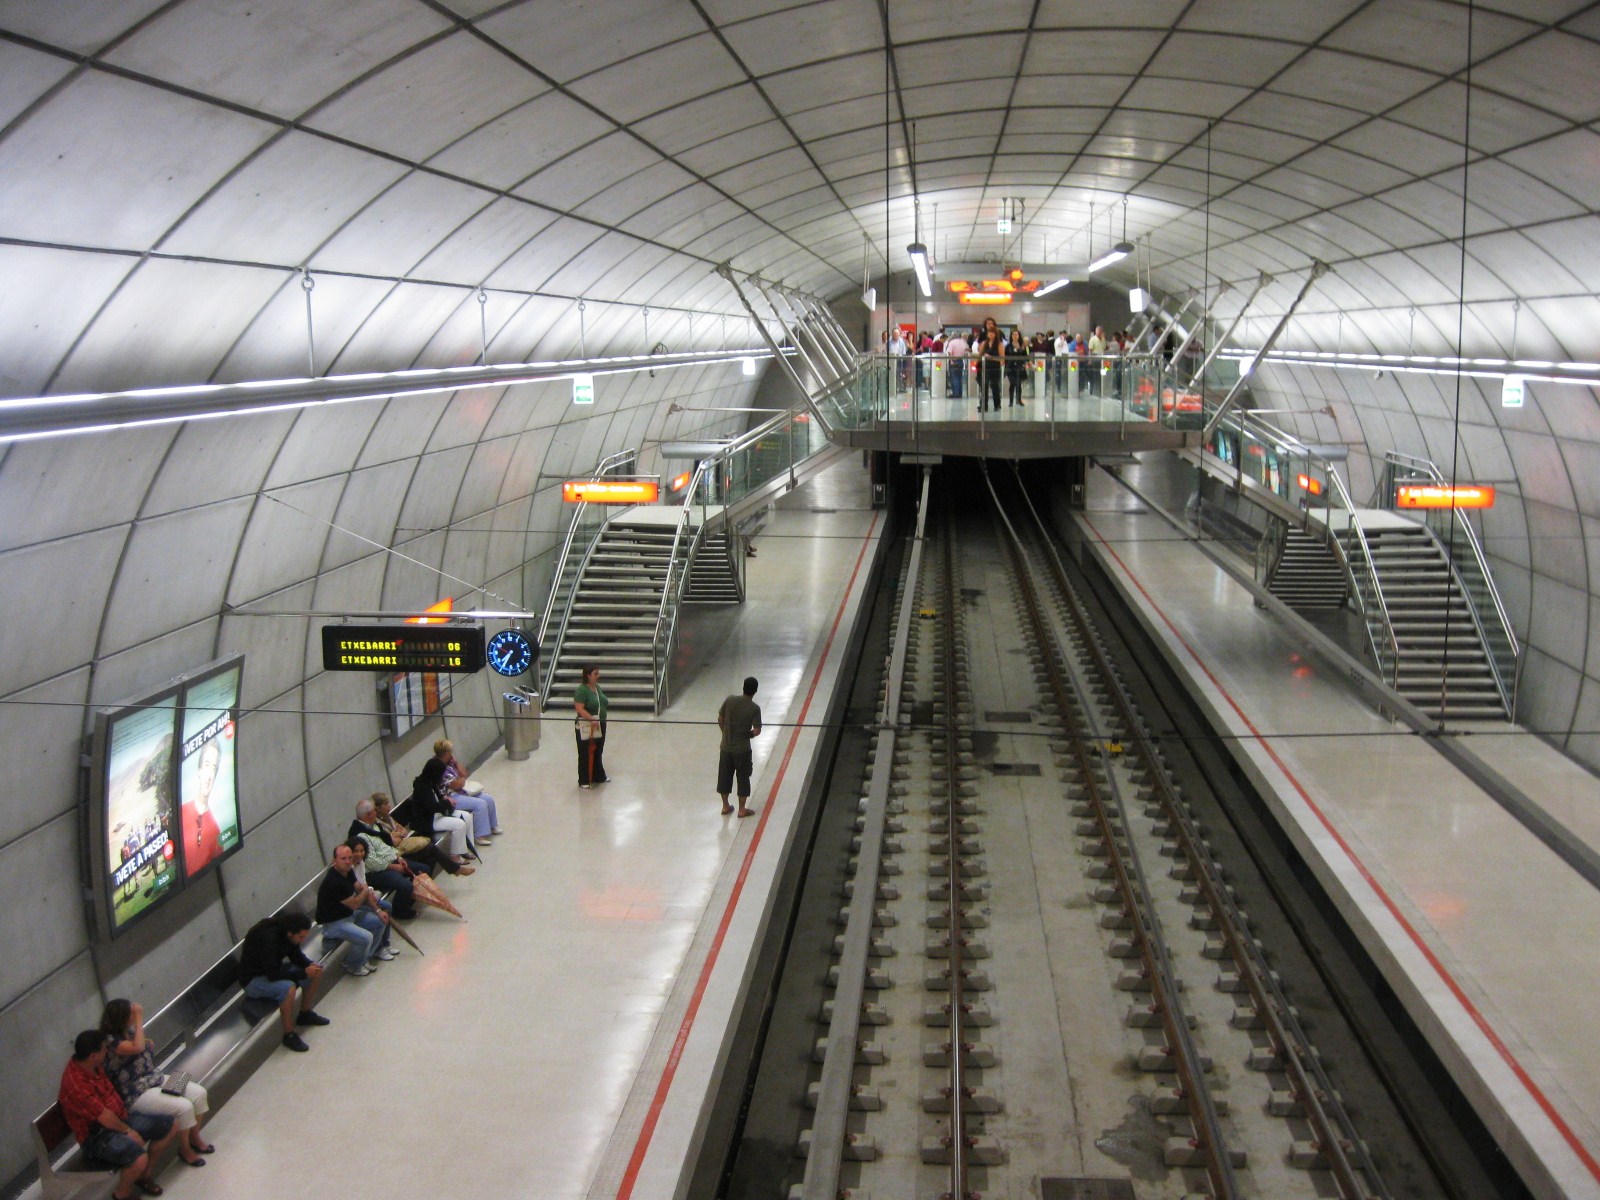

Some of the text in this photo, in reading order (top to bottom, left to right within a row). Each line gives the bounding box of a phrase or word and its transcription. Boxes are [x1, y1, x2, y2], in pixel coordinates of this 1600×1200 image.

[340, 641, 461, 651] ETXEBARRI 06
[341, 655, 461, 666] ETXEBARRI 16
[203, 722, 217, 742] POR
[137, 852, 144, 867] A
[143, 830, 169, 860] PASEO!
